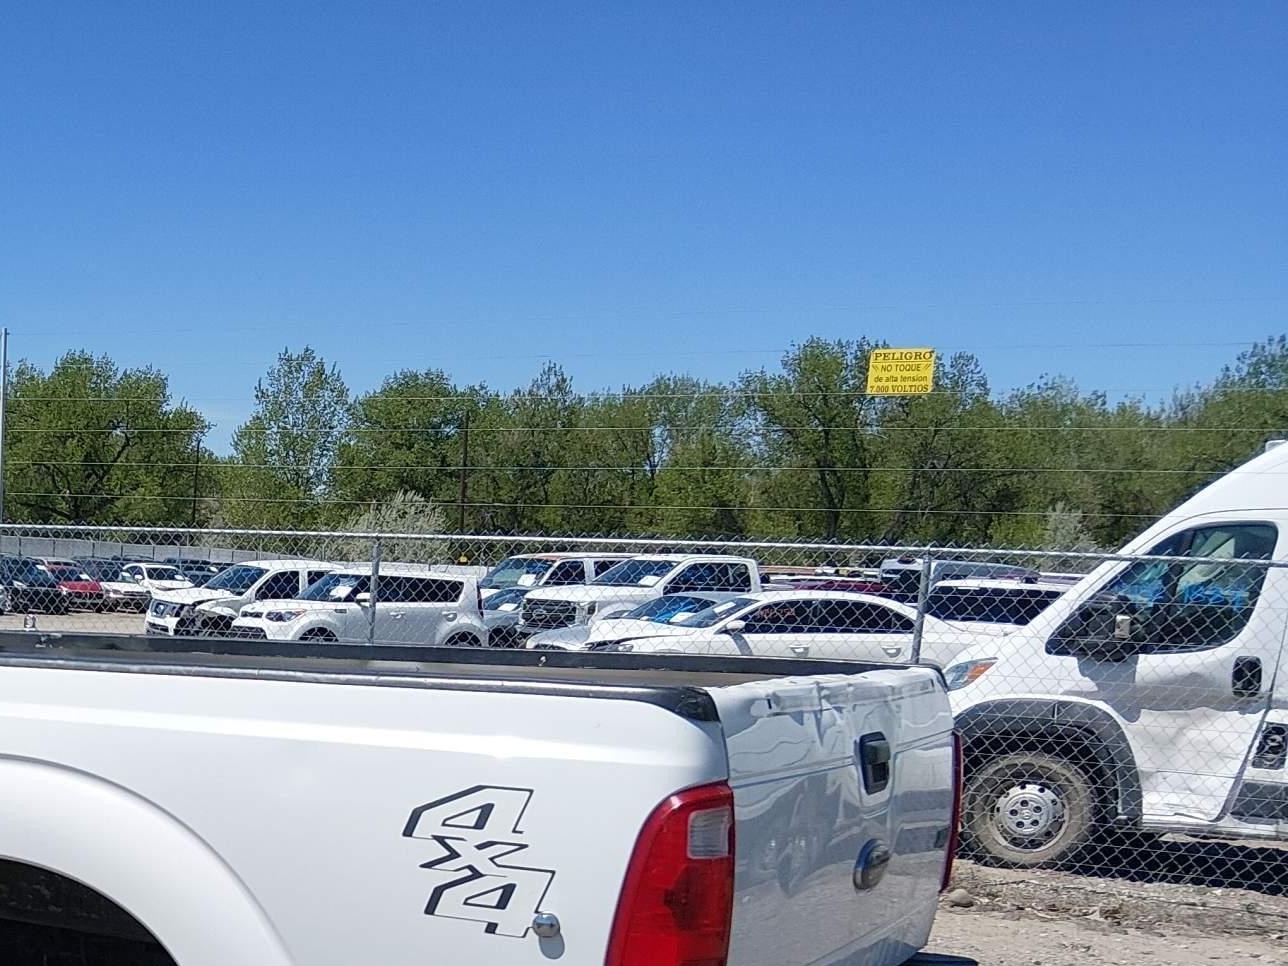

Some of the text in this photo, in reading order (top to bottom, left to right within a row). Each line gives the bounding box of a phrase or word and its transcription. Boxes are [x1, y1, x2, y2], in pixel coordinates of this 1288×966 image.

[874, 351, 933, 360] PELIGRO
[881, 363, 921, 373] NO TOQUE
[874, 375, 883, 383] de
[885, 375, 898, 383] alta
[891, 384, 929, 393] VOLTIOS
